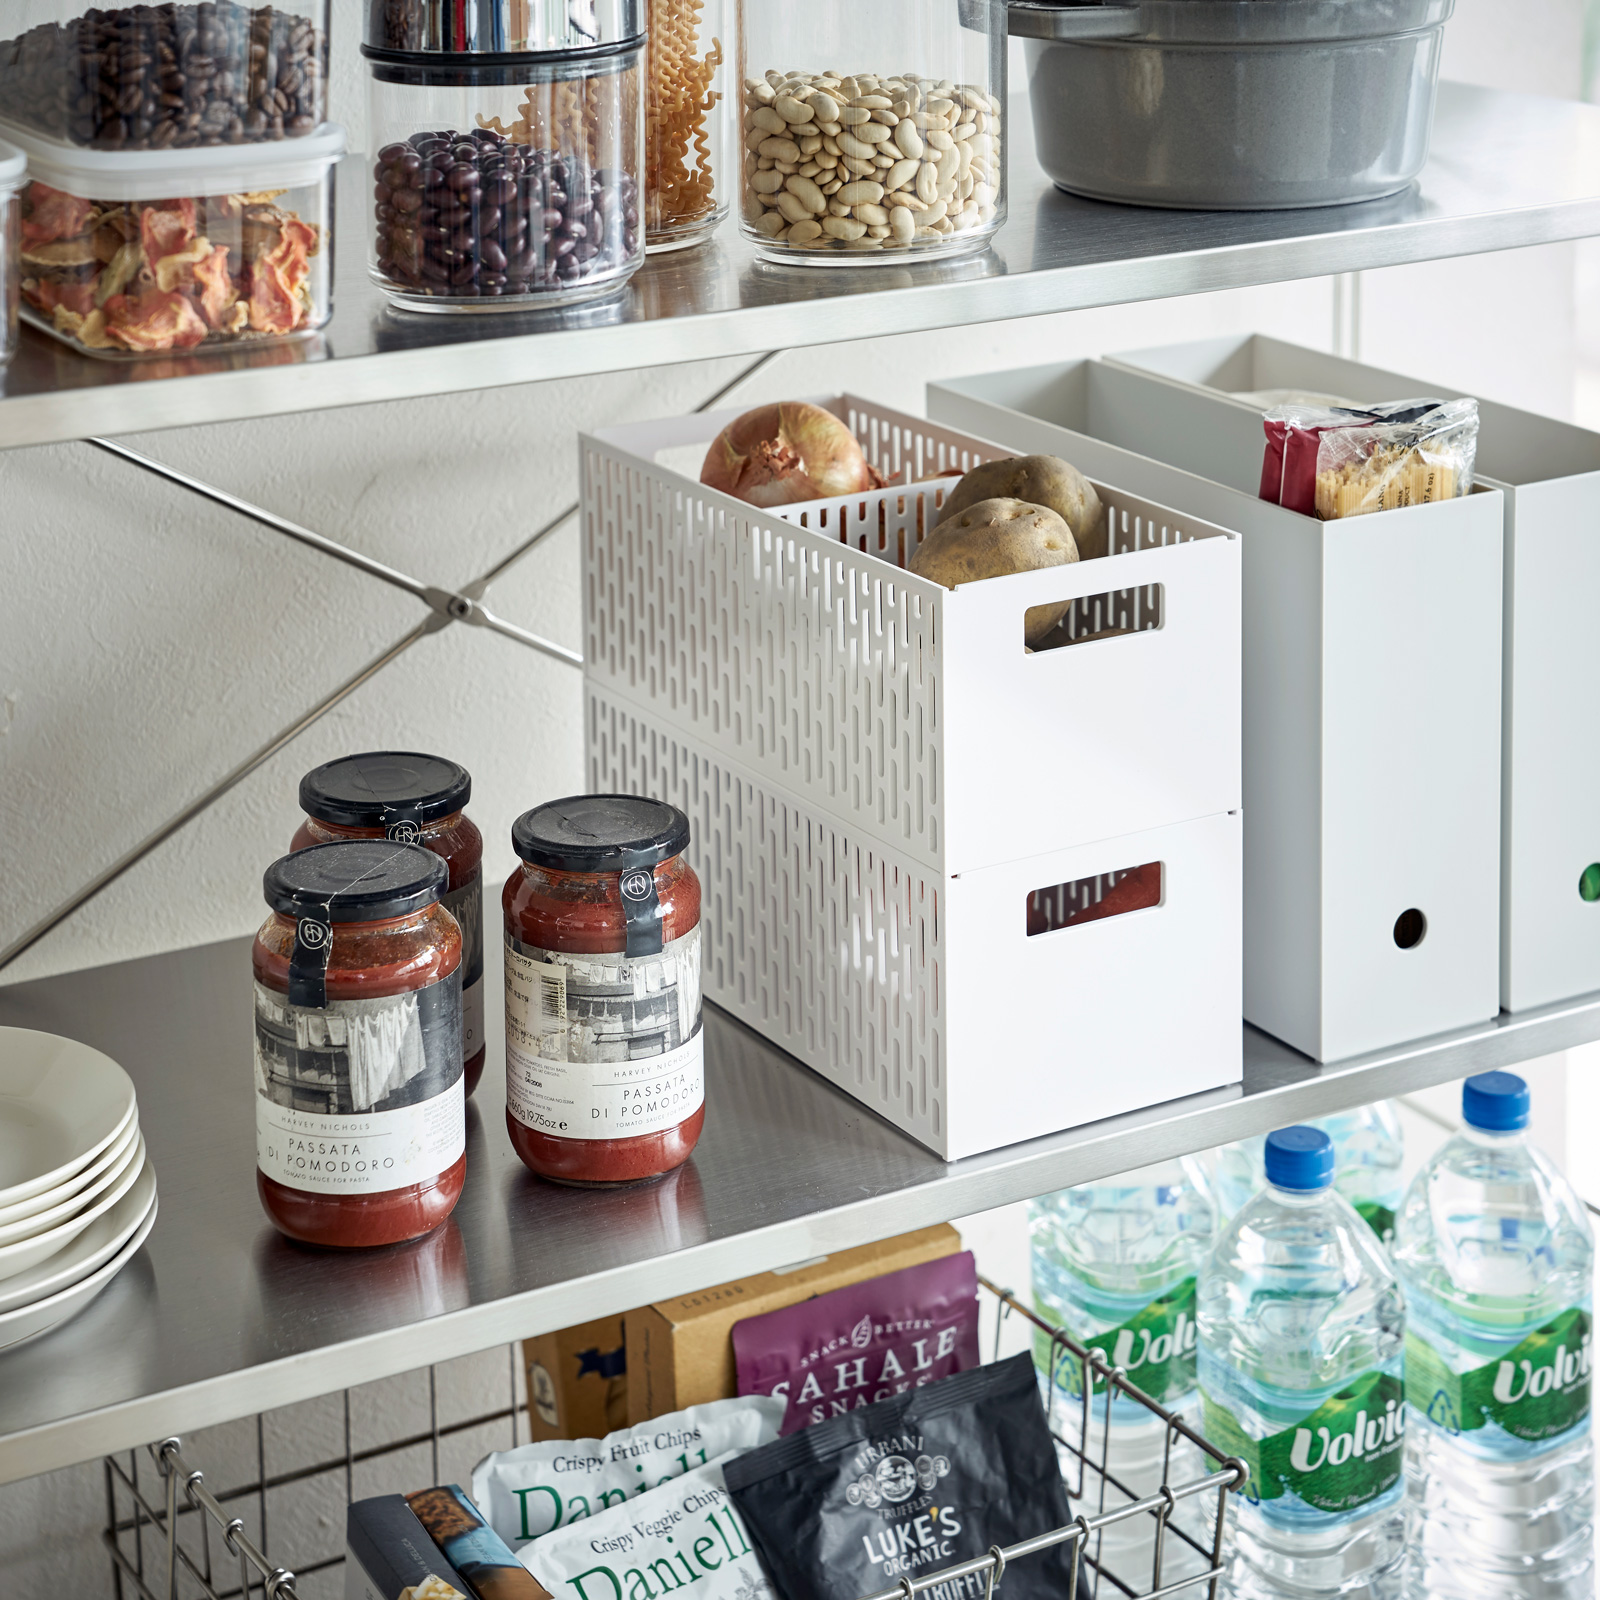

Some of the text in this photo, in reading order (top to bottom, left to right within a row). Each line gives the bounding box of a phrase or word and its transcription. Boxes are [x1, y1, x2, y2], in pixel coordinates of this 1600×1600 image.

[614, 1051, 690, 1078] HARVEY NICHOLS
[591, 1078, 700, 1119] DI POMODORO
[623, 1074, 686, 1100] PASSATA
[281, 1116, 370, 1131] HARVEY NICHOLS
[616, 1119, 643, 1128] TOMATO
[268, 1146, 395, 1173] DI POMODORO
[288, 1138, 361, 1156] PASSATA
[309, 1175, 331, 1183] SAUCE
[801, 1319, 933, 1368] SNACK BETTER
[771, 1326, 957, 1405] SAHALE
[552, 1426, 702, 1474] Crispy Fruit Chips
[855, 1435, 924, 1469] URBANI
[591, 1485, 727, 1555] Crispy Veggie Chips
[876, 1493, 934, 1521] TRUFFLES
[566, 1505, 753, 1600] Daniell
[862, 1506, 961, 1565] LUKE'S
[883, 1540, 952, 1577] ORGANIC
